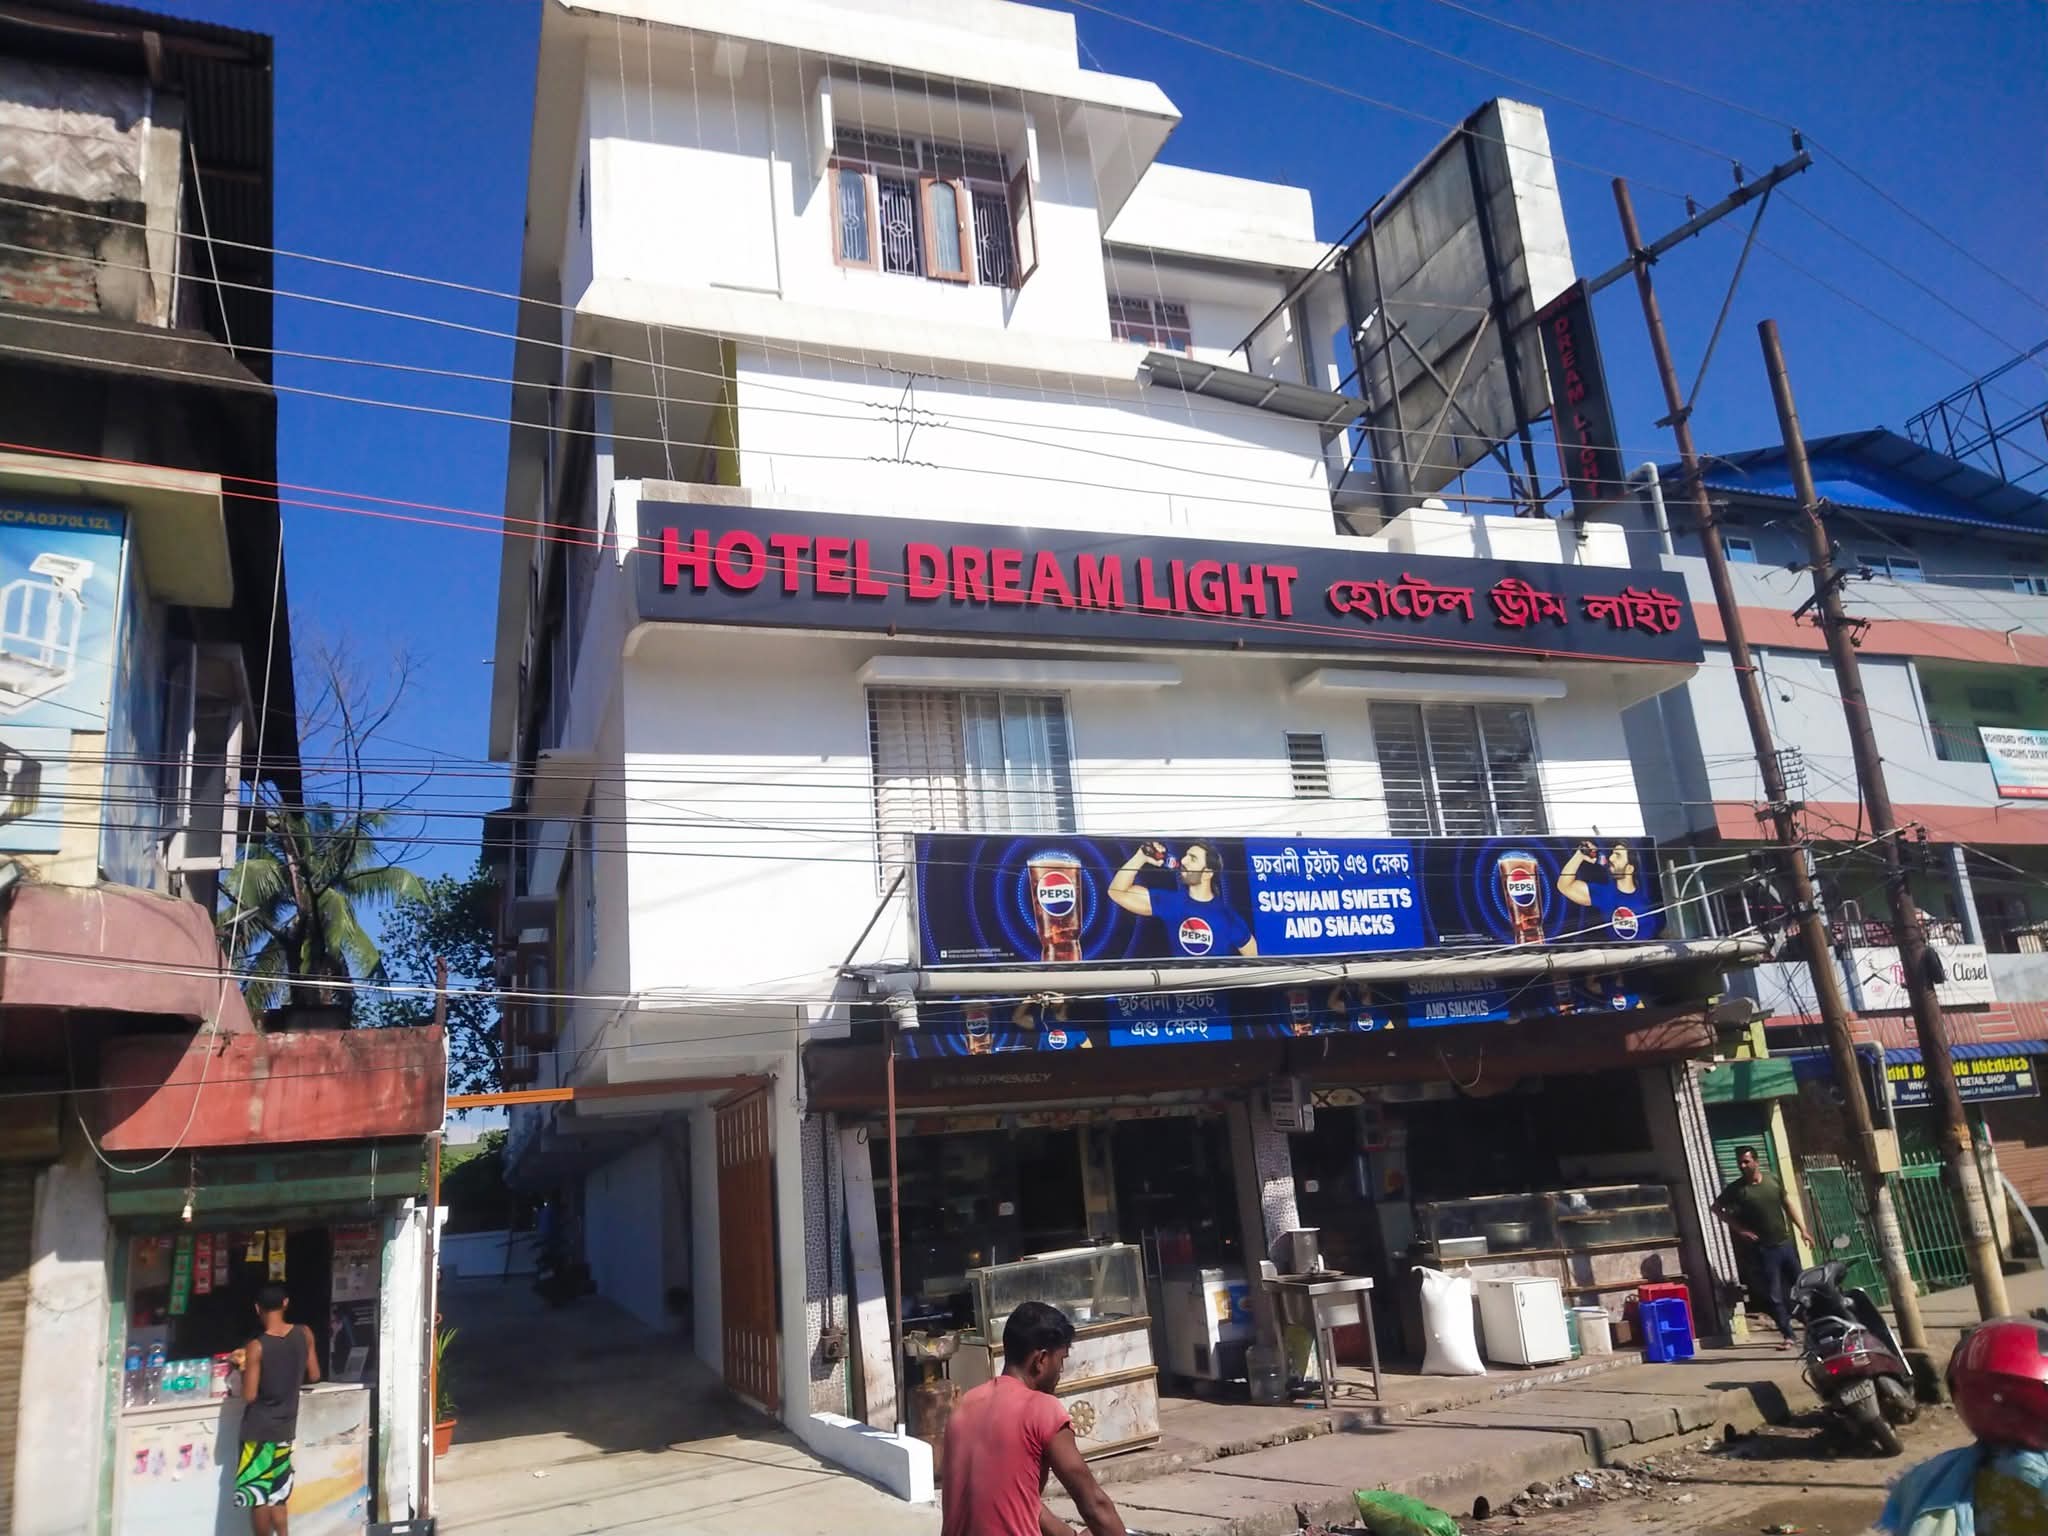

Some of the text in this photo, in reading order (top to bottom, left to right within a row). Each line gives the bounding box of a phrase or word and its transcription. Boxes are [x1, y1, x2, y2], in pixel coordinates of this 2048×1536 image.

[662, 527, 1298, 616] HOTEL DREAM LIGHT
[1328, 572, 1475, 620] হোটেল
[1583, 586, 1683, 634] লাইট
[1039, 888, 1074, 899] PEPSI
[1509, 883, 1535, 892] PEPSI
[1258, 888, 1412, 912] SUSWANI SWEETS
[1181, 929, 1211, 943] PEPSI
[1285, 914, 1395, 939] AND SNACKS
[1425, 1000, 1489, 1020] AND SNACKS
[1960, 1076, 1985, 1087] RETAIL
[1986, 1074, 2006, 1085] SHOP
